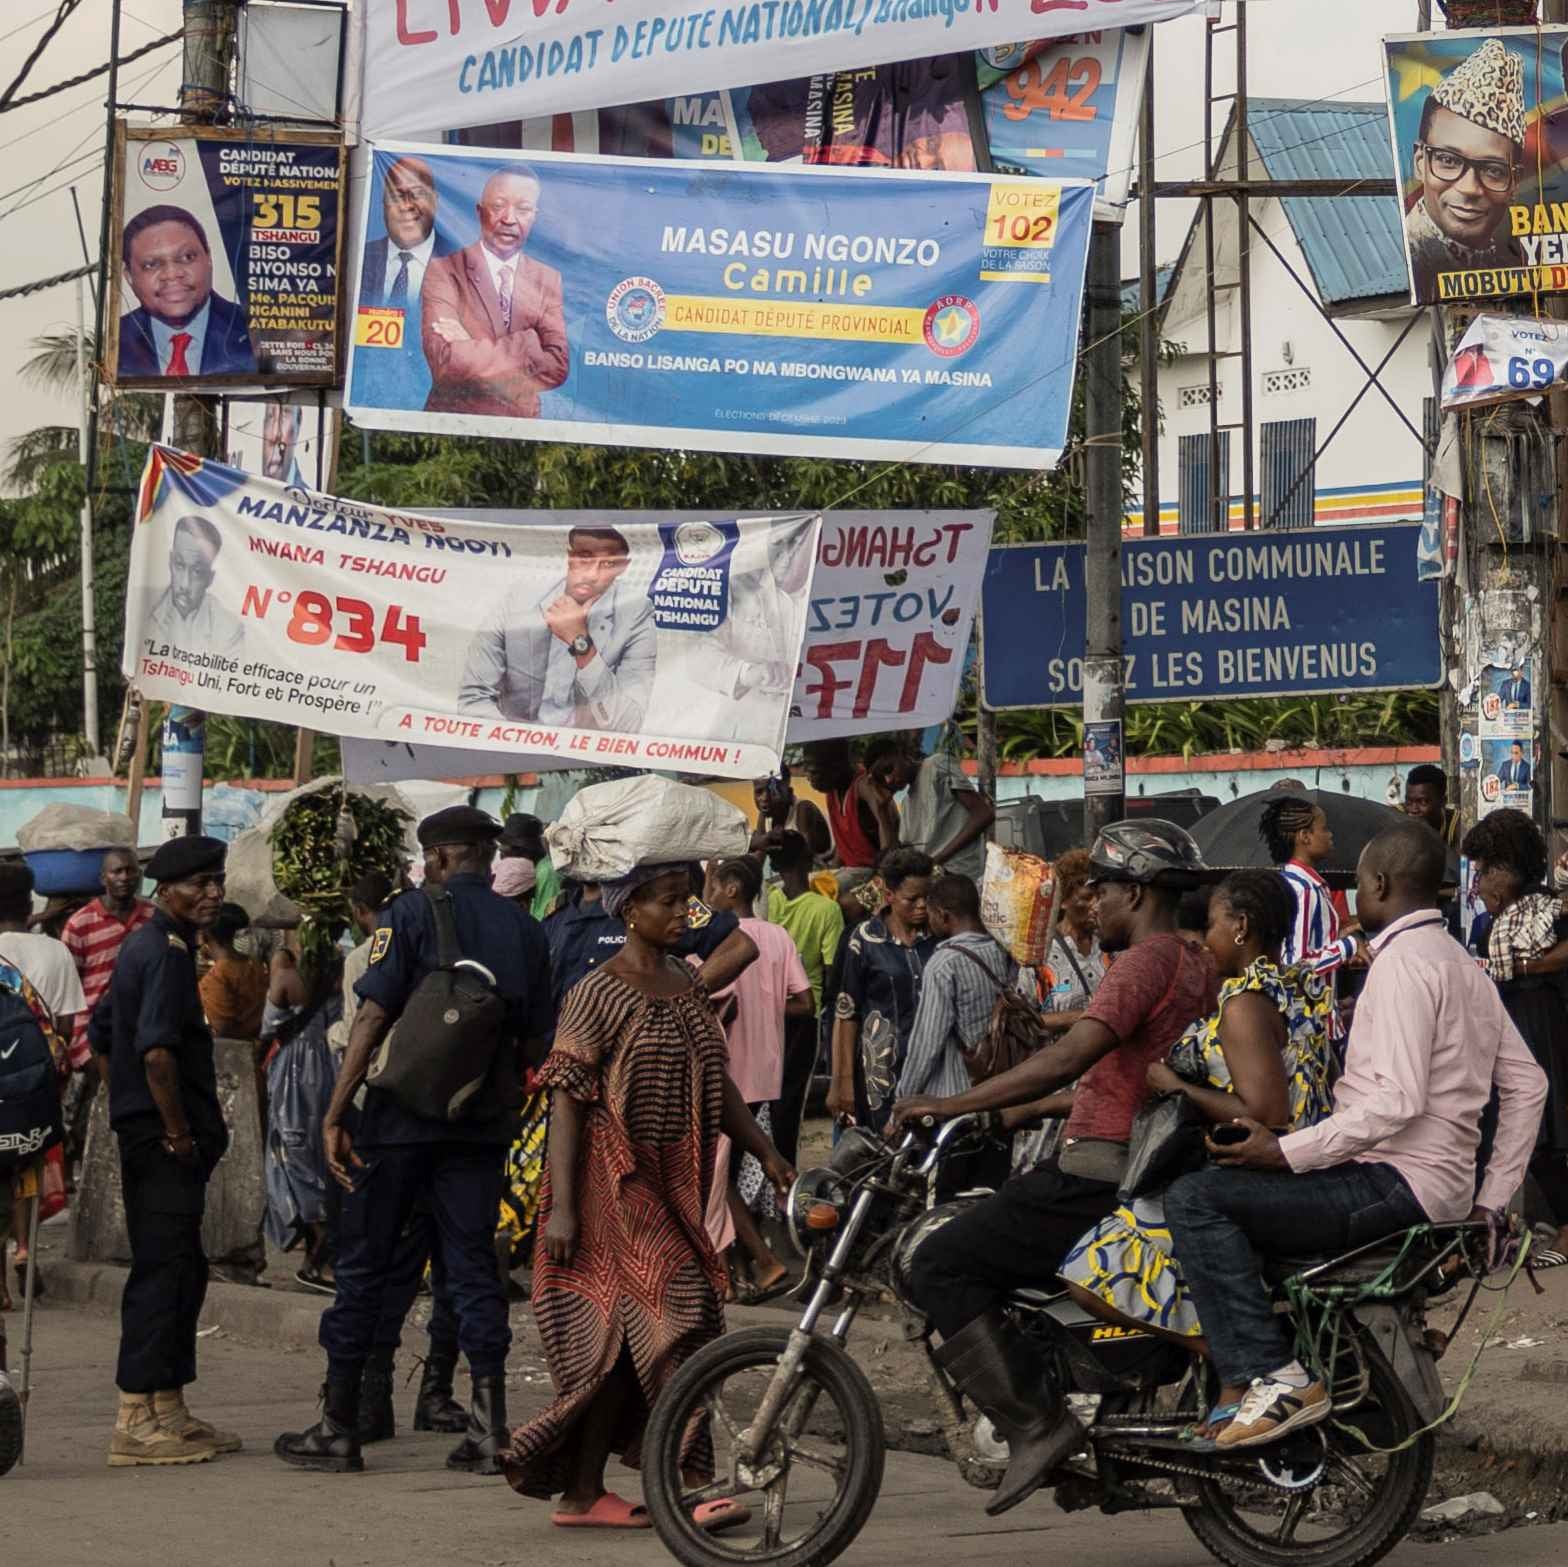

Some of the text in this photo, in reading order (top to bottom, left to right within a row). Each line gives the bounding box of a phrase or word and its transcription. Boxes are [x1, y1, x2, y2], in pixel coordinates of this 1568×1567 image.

[458, 13, 712, 94] CANDIDAT DEPUTE
[1003, 57, 1101, 122] 942
[219, 148, 295, 162] CANDIDAT
[252, 194, 321, 229] 315
[992, 214, 1053, 243] 102
[660, 226, 941, 267] MASASU NGONZO
[723, 262, 873, 297] Camille
[1441, 269, 1543, 298] MOBUTU
[674, 305, 912, 336] CANDIDAT DÉPUTÉ PROVINCIAL
[1507, 356, 1555, 390] 69
[248, 535, 447, 585] MWANA TSHANGU
[1034, 539, 1386, 592] LA AISON COMMUNALE
[1130, 597, 1291, 638] DE MASINA
[1152, 642, 1377, 687] LES BIENVENUS
[226, 679, 361, 716] Fort et Prospère
[569, 734, 728, 763] LE BIEN COMMUN
